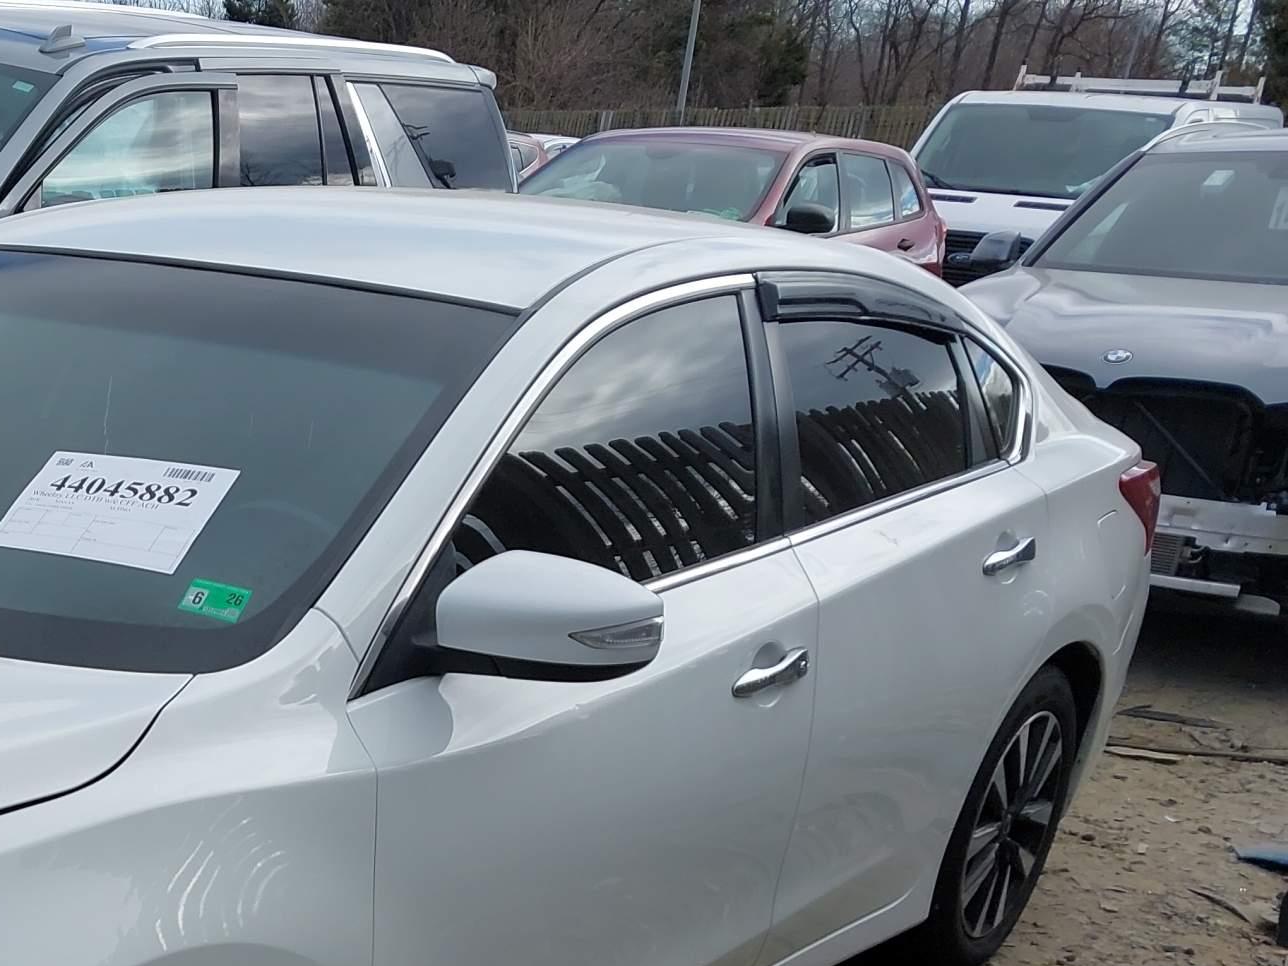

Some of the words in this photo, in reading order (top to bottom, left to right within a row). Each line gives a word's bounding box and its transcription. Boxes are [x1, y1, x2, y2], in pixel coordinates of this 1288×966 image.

[50, 473, 199, 508] 44045882
[191, 591, 205, 605] 6
[226, 592, 245, 607] 26
